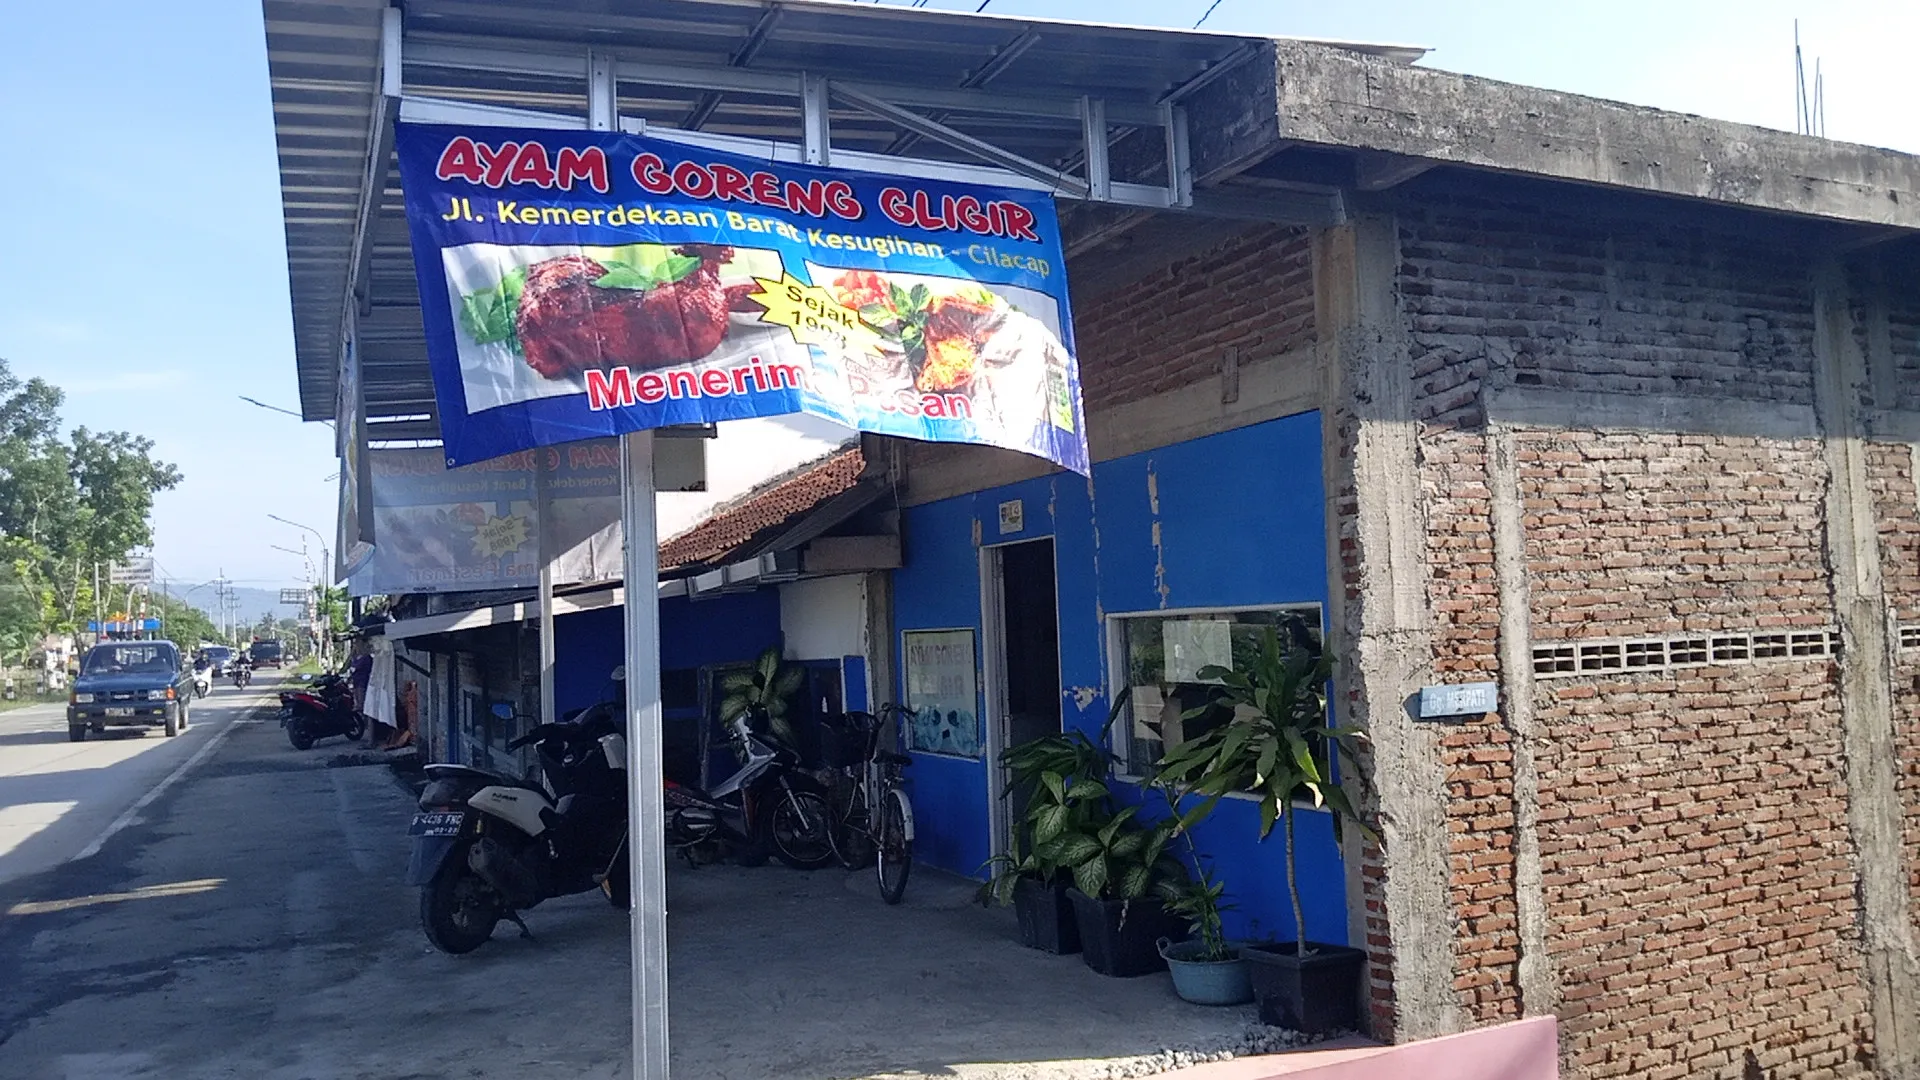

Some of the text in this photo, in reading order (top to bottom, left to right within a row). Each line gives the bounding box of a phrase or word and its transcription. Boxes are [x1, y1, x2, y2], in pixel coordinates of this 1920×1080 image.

[436, 136, 1039, 242] AYAM GORENG GLIGIR
[442, 197, 484, 222] Jl.
[497, 200, 718, 228] Kemerdekaan
[726, 210, 801, 243] Barat
[806, 228, 944, 259] Kesugihan
[967, 244, 1050, 279] Cilacap
[786, 285, 854, 331] Sejak
[584, 355, 817, 411] Menerim
[1447, 689, 1486, 708] MERPATI
